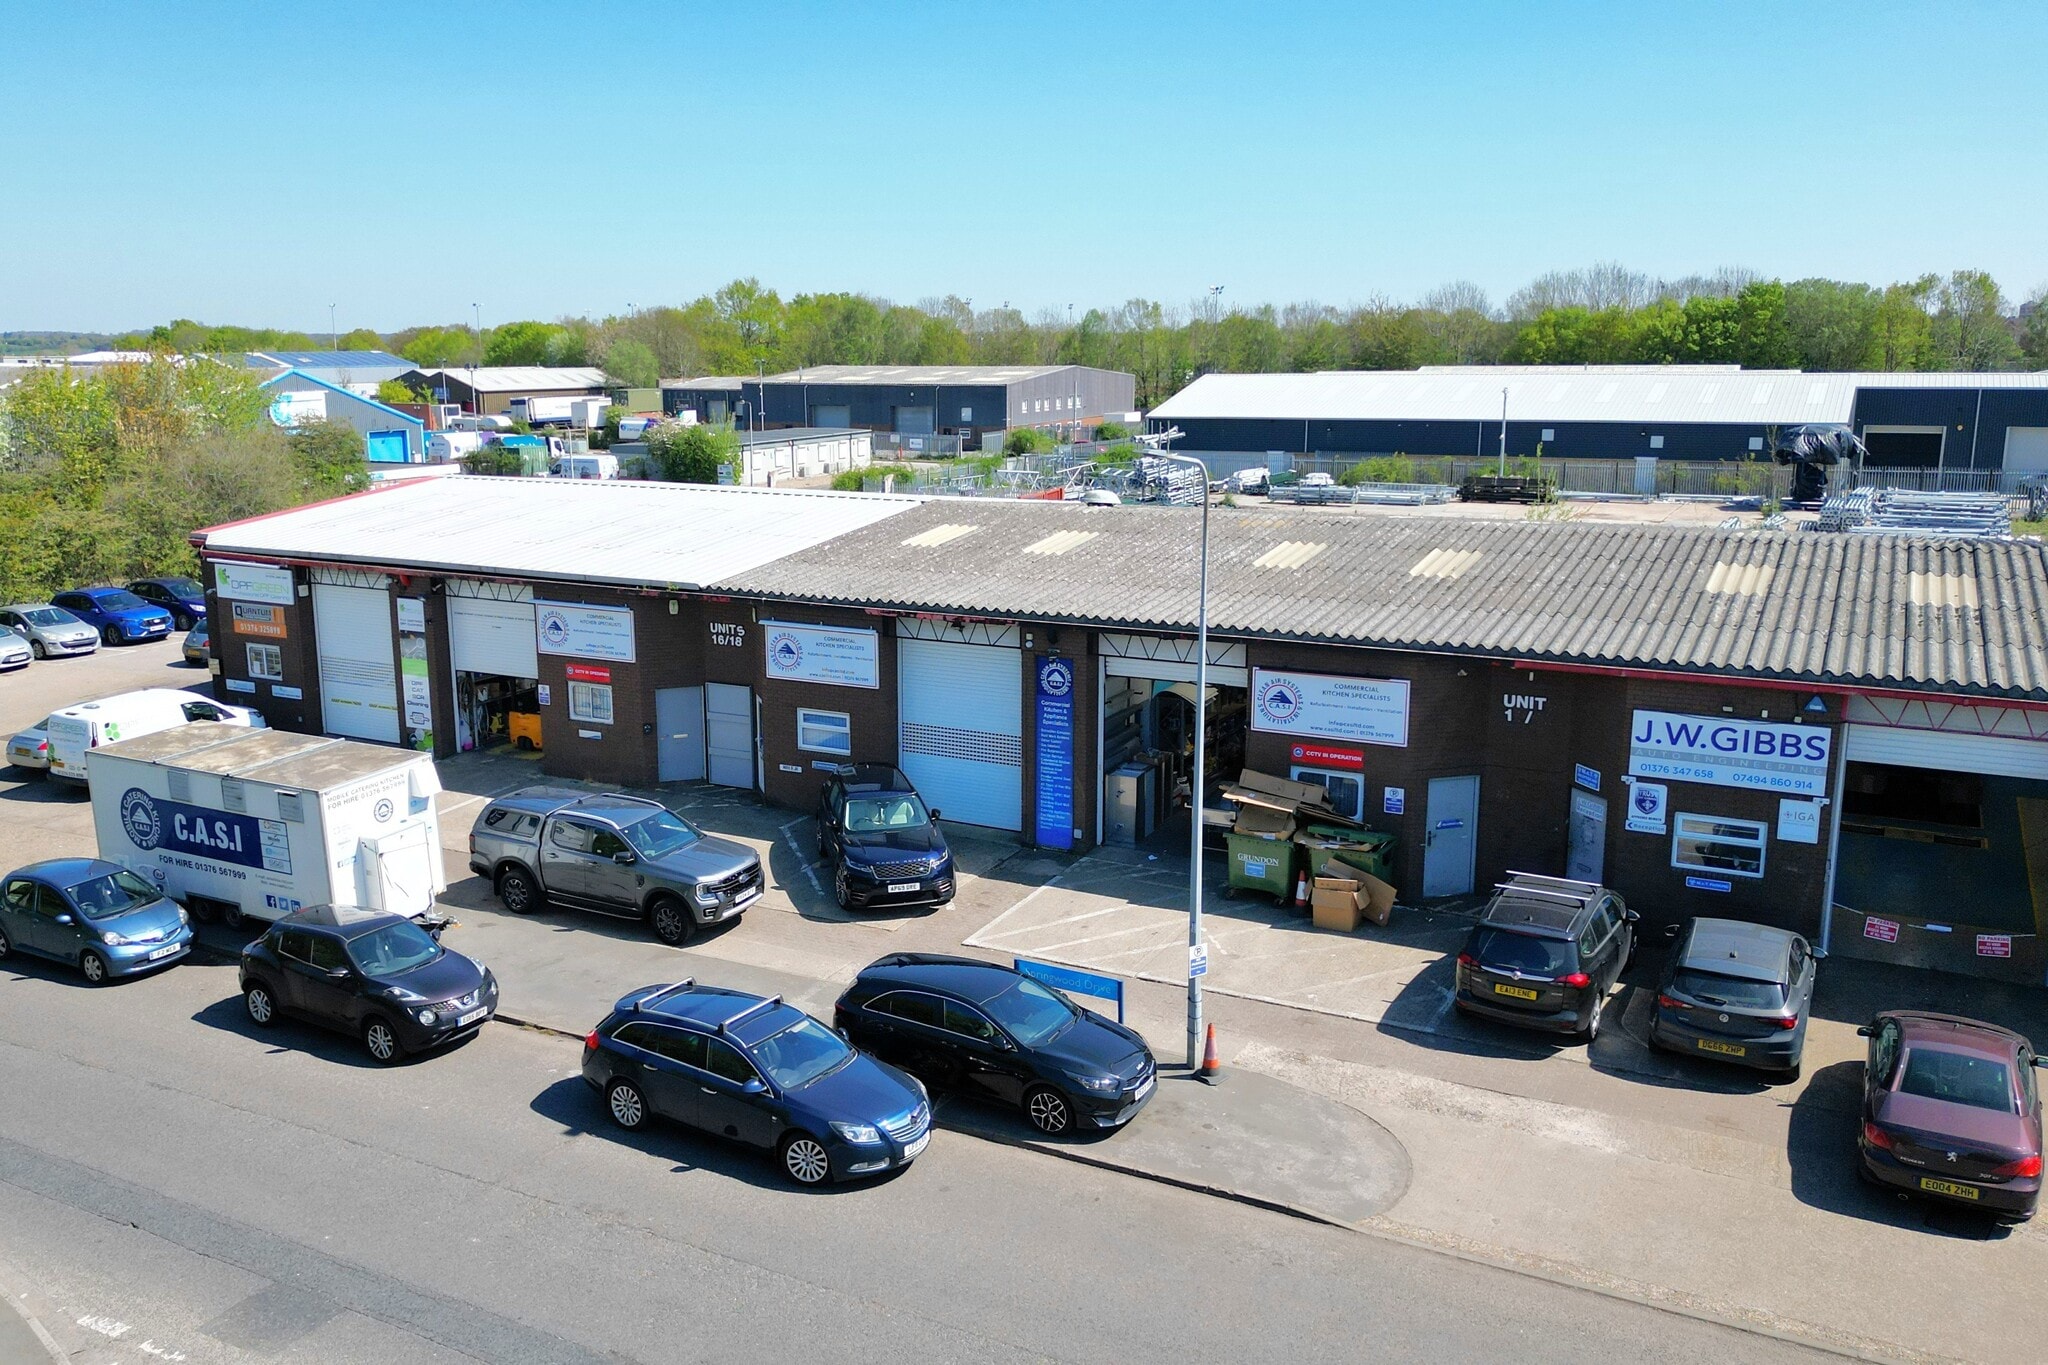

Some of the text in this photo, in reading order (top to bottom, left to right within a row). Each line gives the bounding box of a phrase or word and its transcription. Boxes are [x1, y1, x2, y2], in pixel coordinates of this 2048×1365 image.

[710, 623, 745, 636] UNITS
[711, 635, 743, 647] 16/18
[824, 635, 856, 644] COMMERCIAL
[1334, 683, 1379, 693] COMMERCIAL
[1322, 690, 1391, 701] KITCHEN SPECIALISTS
[1503, 694, 1547, 711] UNIT
[1635, 719, 1826, 761] J.W.GIBBS
[1330, 753, 1362, 762] OPERATION
[1634, 749, 1823, 775] AUTO ENGINEERING
[1640, 763, 1813, 790] 01376 347 658 07494 860 914
[327, 774, 404, 802] MOBILE CATERING KITCHEN
[328, 800, 342, 810] FOR
[343, 796, 359, 805] HIRE
[123, 791, 153, 810] CATERING
[147, 810, 161, 847] KITCHEN
[1793, 812, 1815, 822] IGA
[174, 813, 243, 852] C.A.S.I
[1238, 853, 1279, 866] GRUNDON
[159, 854, 247, 880] FOR HIRE 01376 567999
[1025, 968, 1111, 994] Springwood Drive
[1499, 985, 1531, 998] EA13 ENE
[1725, 1045, 1742, 1054] ZHP
[1954, 1185, 1974, 1197] ZHH
